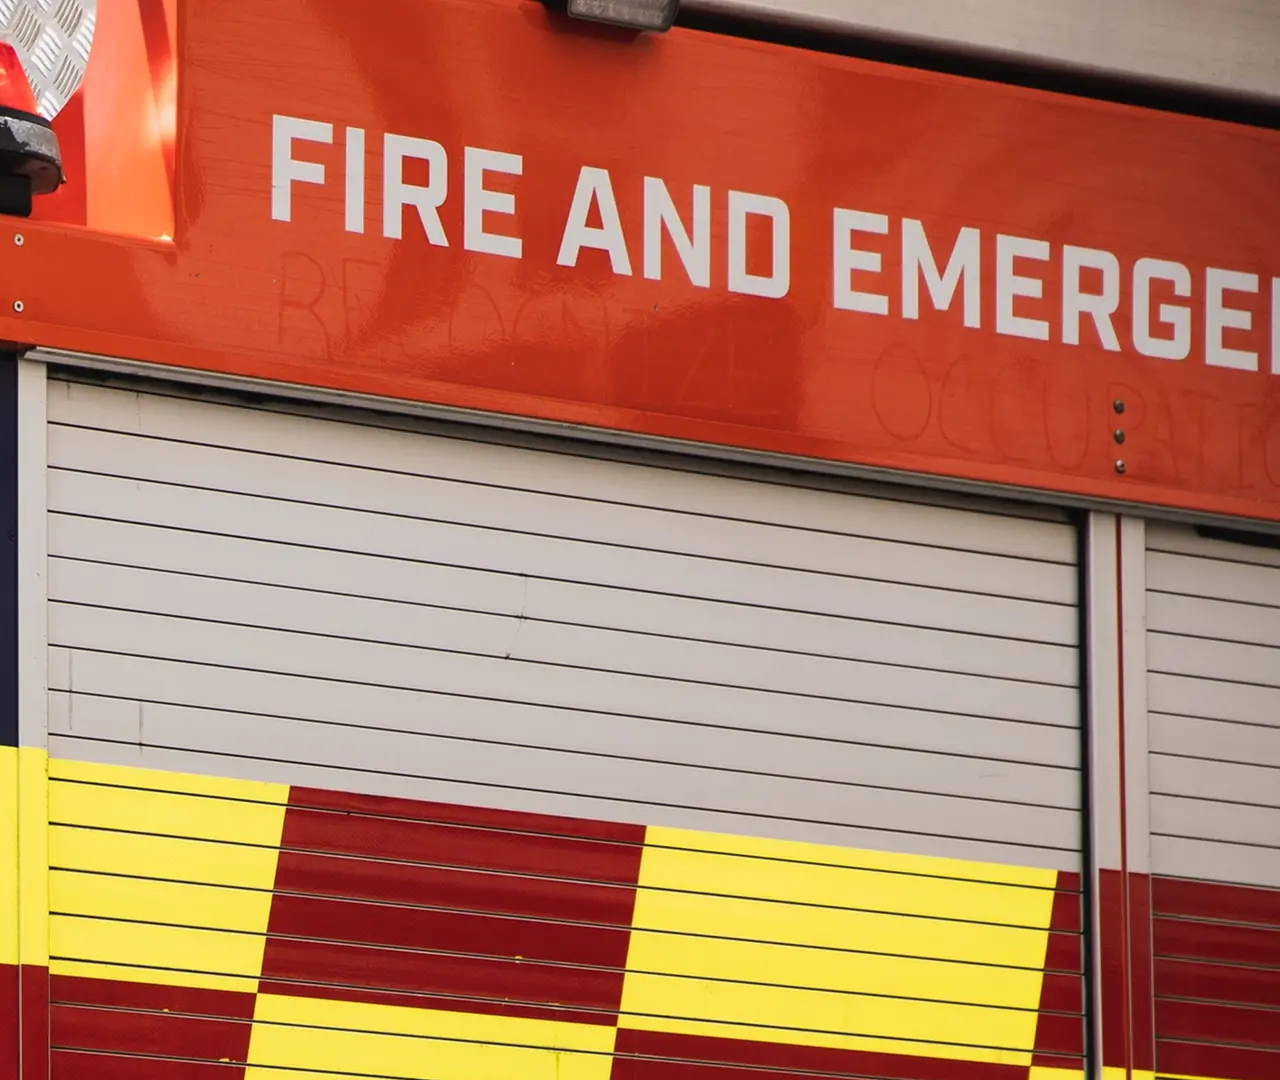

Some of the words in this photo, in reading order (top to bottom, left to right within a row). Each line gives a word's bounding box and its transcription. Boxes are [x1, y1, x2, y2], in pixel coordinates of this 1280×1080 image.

[271, 113, 523, 259] FIRE
[556, 166, 791, 300] AND
[833, 207, 1280, 375] EMERGE
